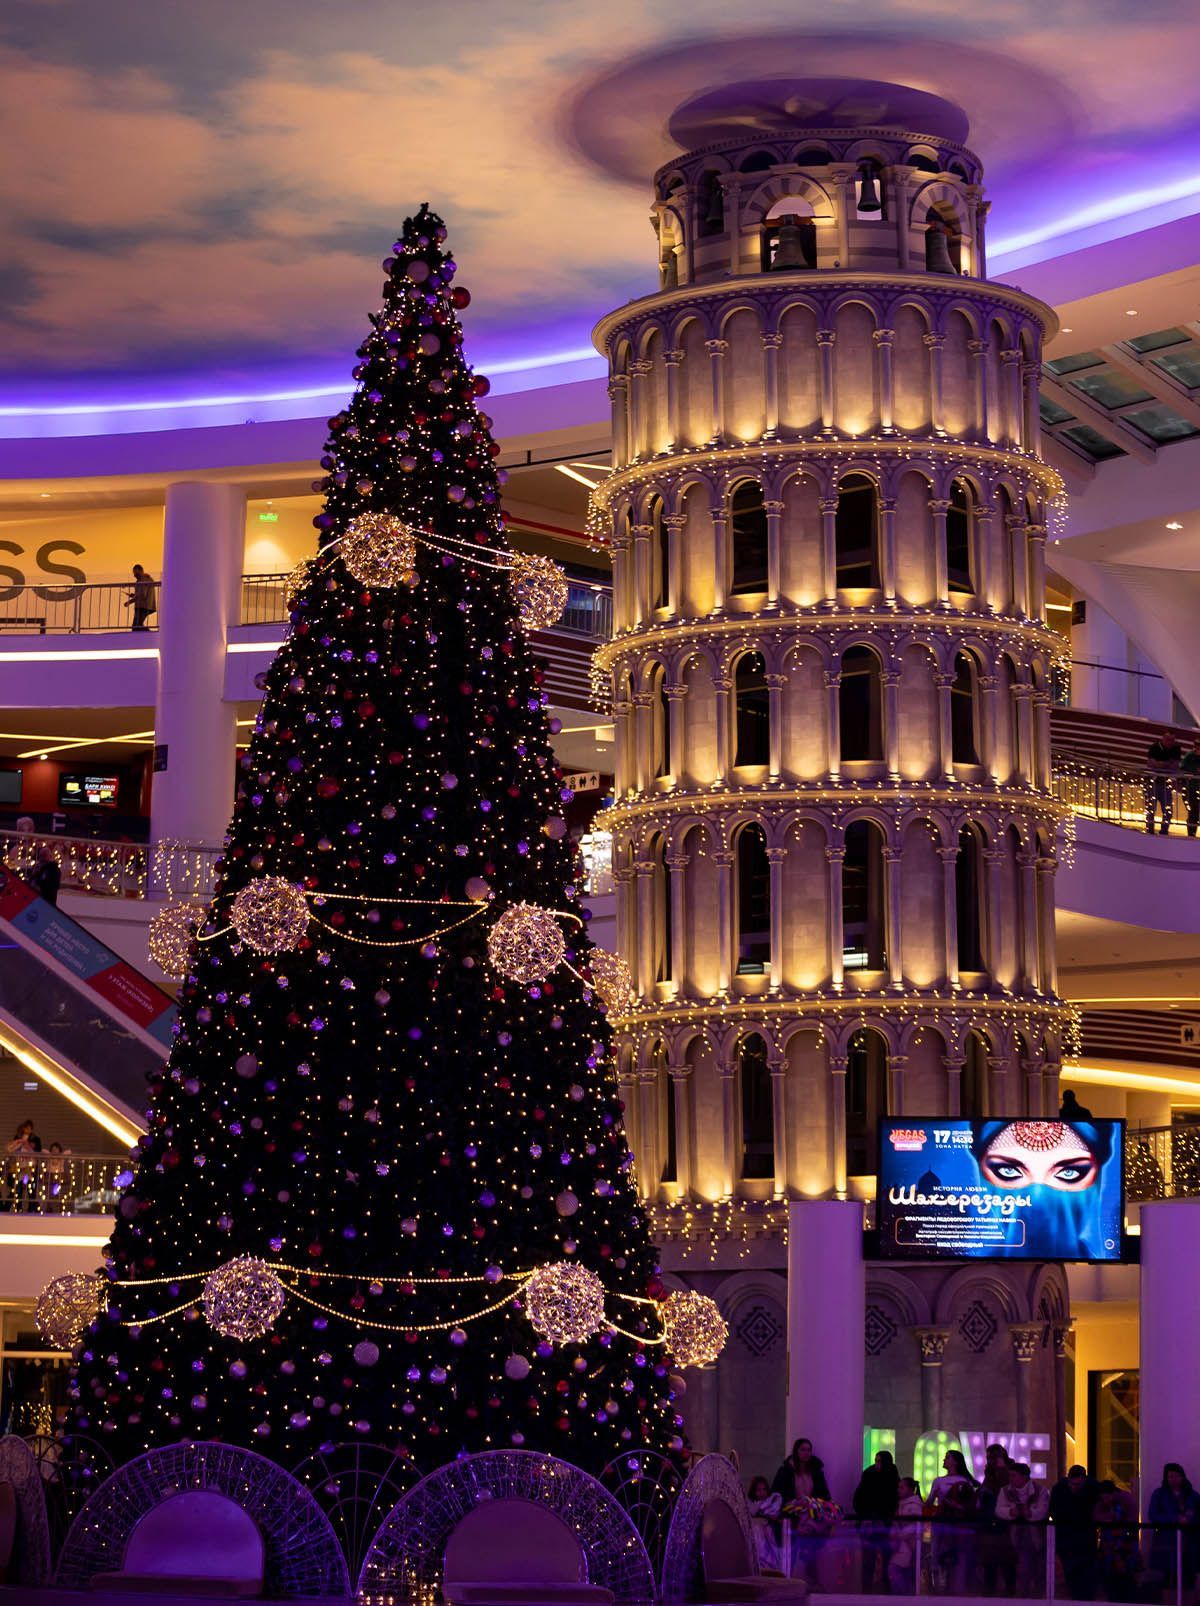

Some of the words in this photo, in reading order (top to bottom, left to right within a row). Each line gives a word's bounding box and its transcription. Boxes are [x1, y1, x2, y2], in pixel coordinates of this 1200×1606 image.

[891, 1129, 925, 1140] VEGAS
[933, 1130, 951, 1144] 17
[889, 1184, 1032, 1215] Шахерезады
